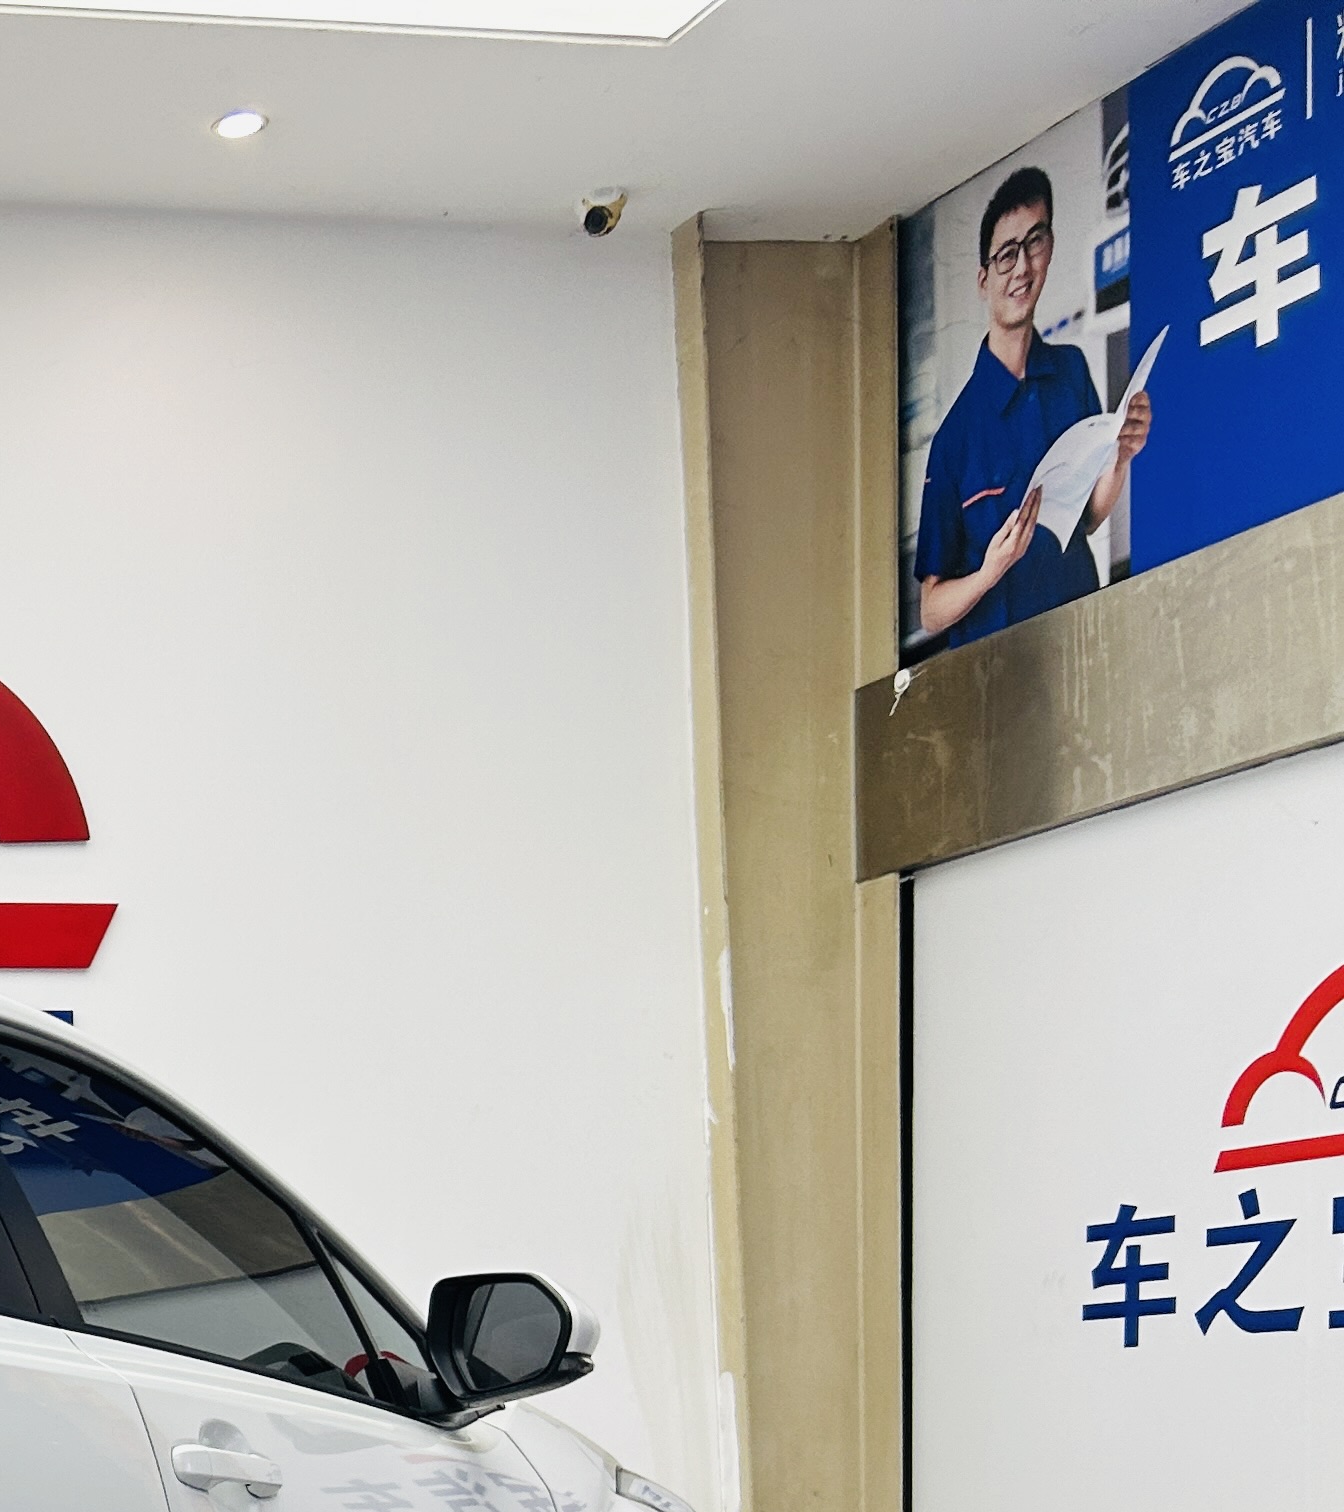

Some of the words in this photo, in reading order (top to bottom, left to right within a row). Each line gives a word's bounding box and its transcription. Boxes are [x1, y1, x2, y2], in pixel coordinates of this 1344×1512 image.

[1171, 109, 1282, 191] 车之宝汽车
[1206, 93, 1243, 123] CZB
[1200, 175, 1320, 348] 车
[1082, 1188, 1344, 1348] 车之
